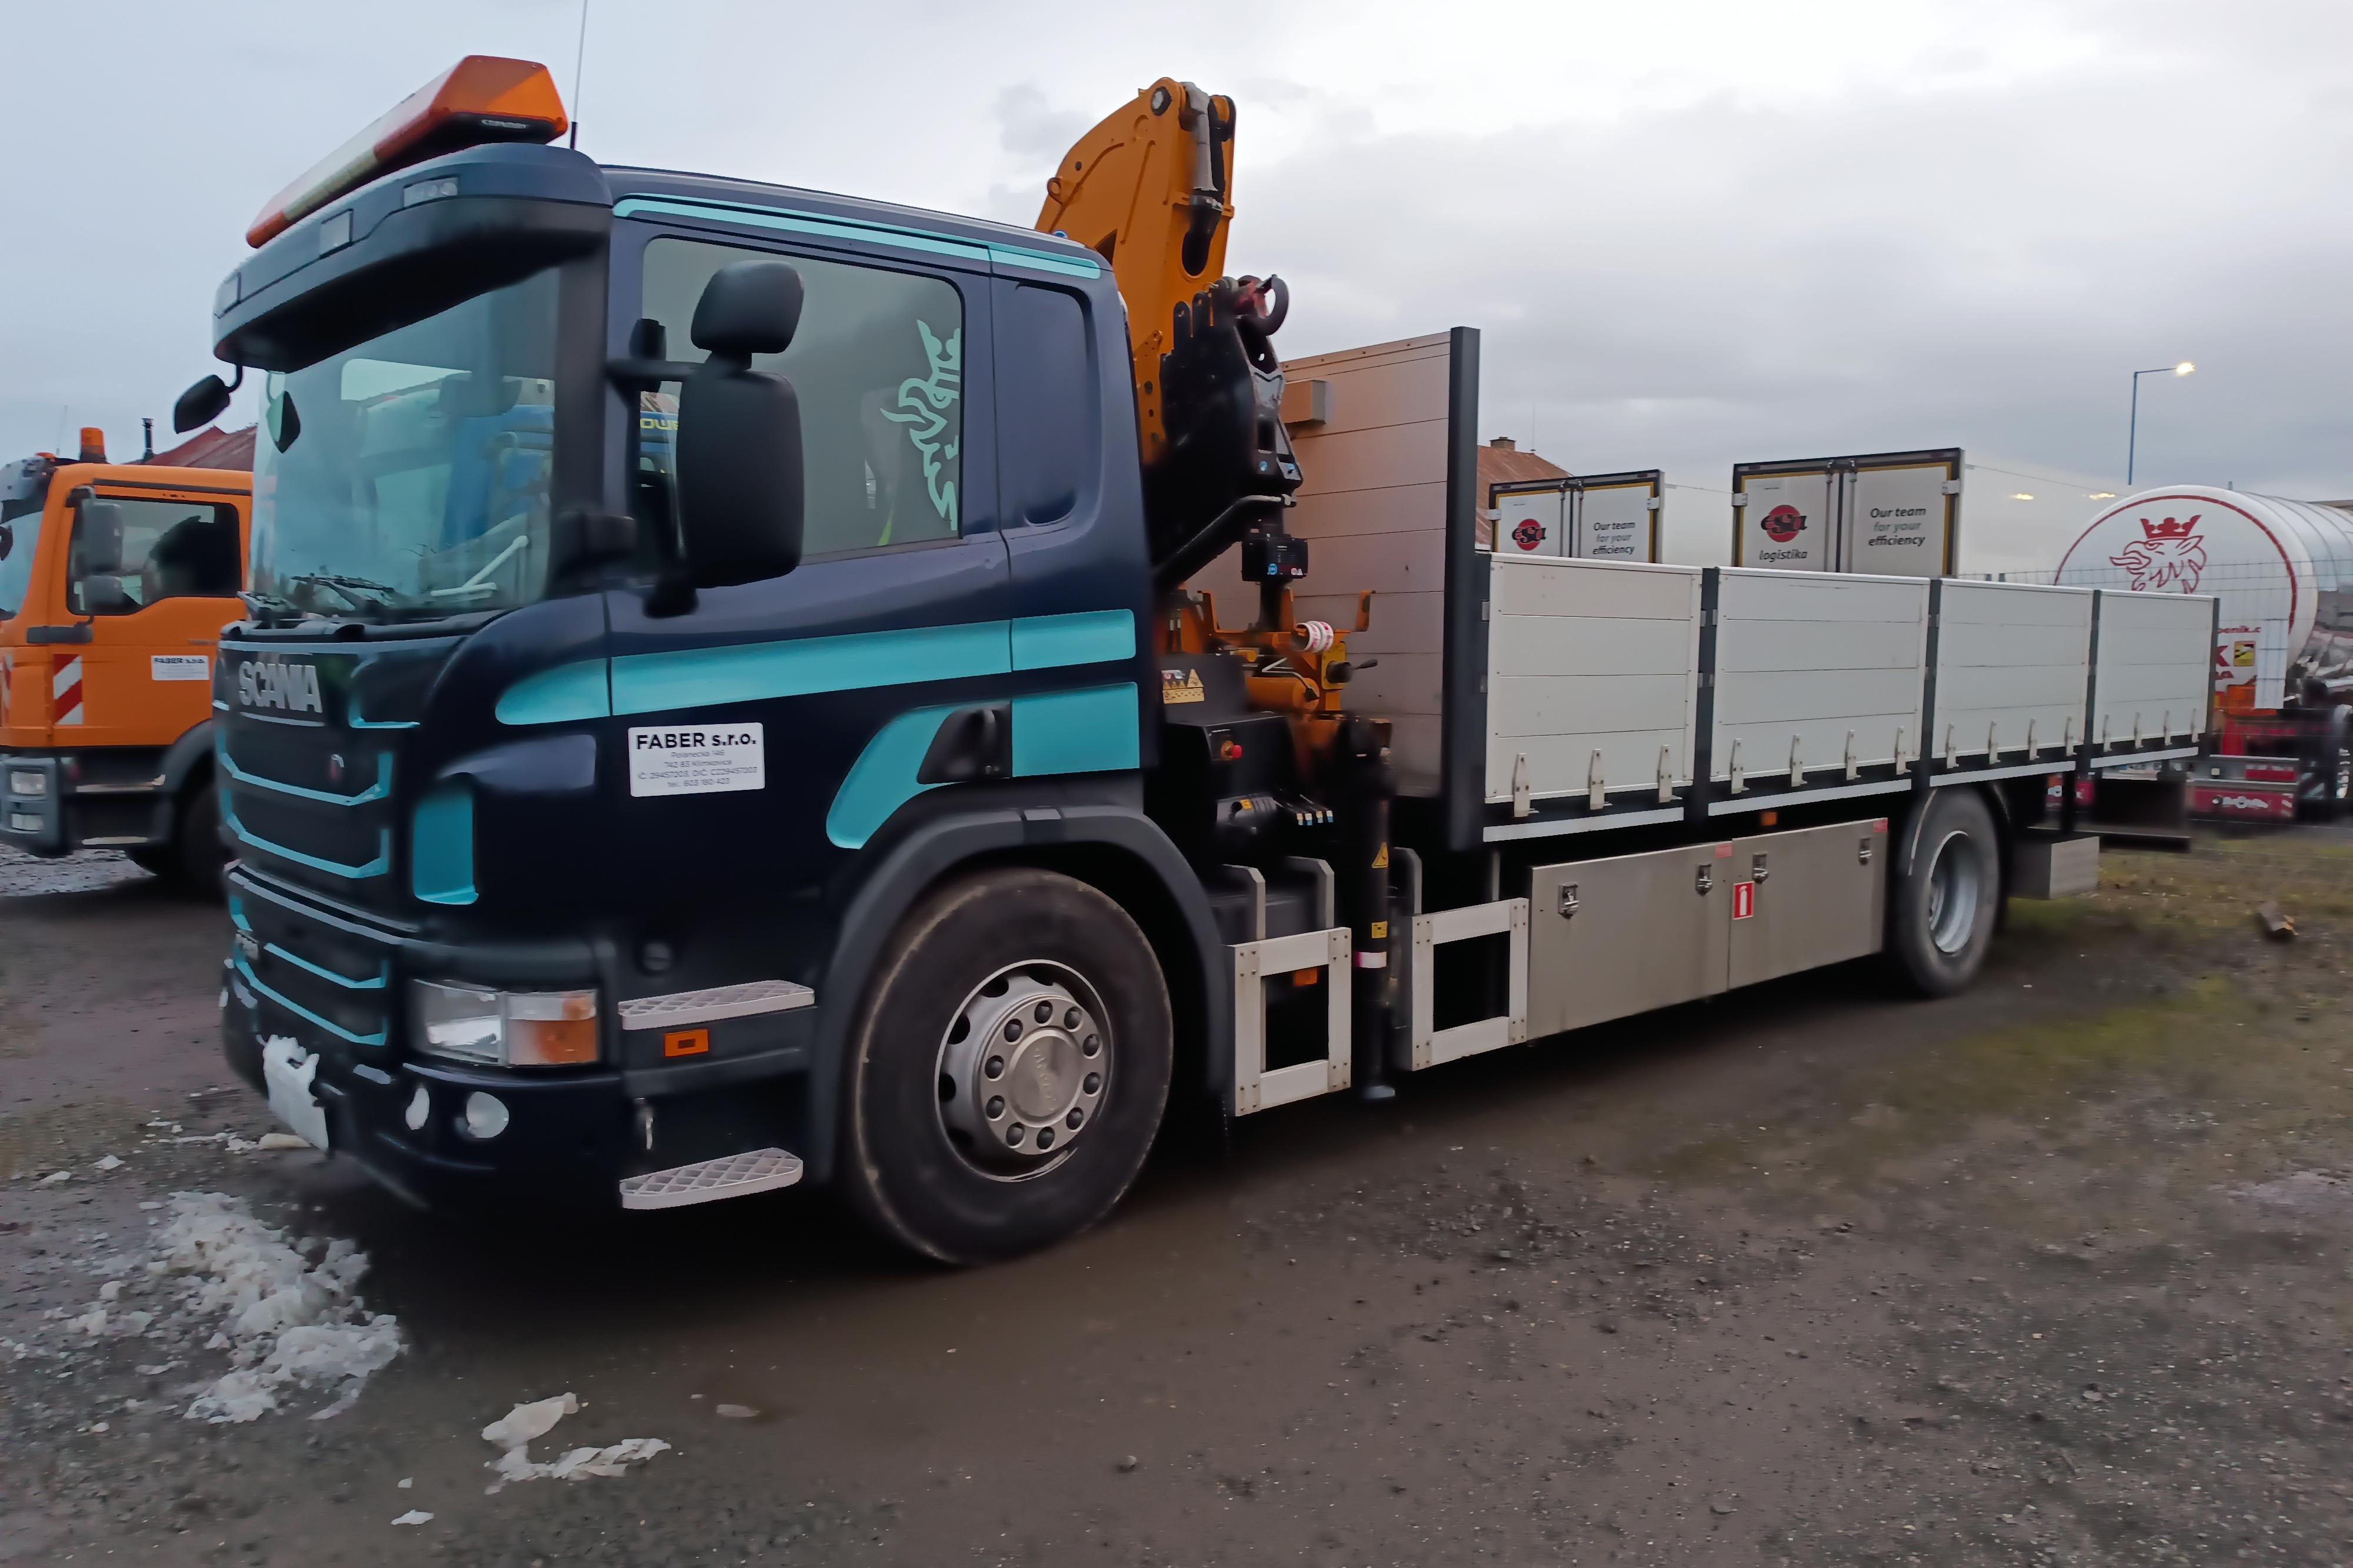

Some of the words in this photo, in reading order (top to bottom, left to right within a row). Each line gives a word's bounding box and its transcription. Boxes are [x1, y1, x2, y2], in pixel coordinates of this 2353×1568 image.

[1870, 508, 1892, 518] Our
[1895, 508, 1927, 517] team
[1593, 522, 1611, 531] Our
[1612, 522, 1636, 530] team
[1761, 514, 1808, 533] esa
[1874, 522, 1890, 532] for
[1893, 522, 1922, 533] your
[1512, 526, 1547, 543] esa
[1596, 533, 1609, 543] for
[1611, 533, 1632, 544] your
[1868, 535, 1926, 547] efficiency
[1592, 545, 1635, 555] efficiency
[1759, 549, 1808, 563] logistika
[238, 660, 324, 713] SCANIA
[636, 732, 706, 750] FABER
[711, 733, 757, 746] s.r.o.
